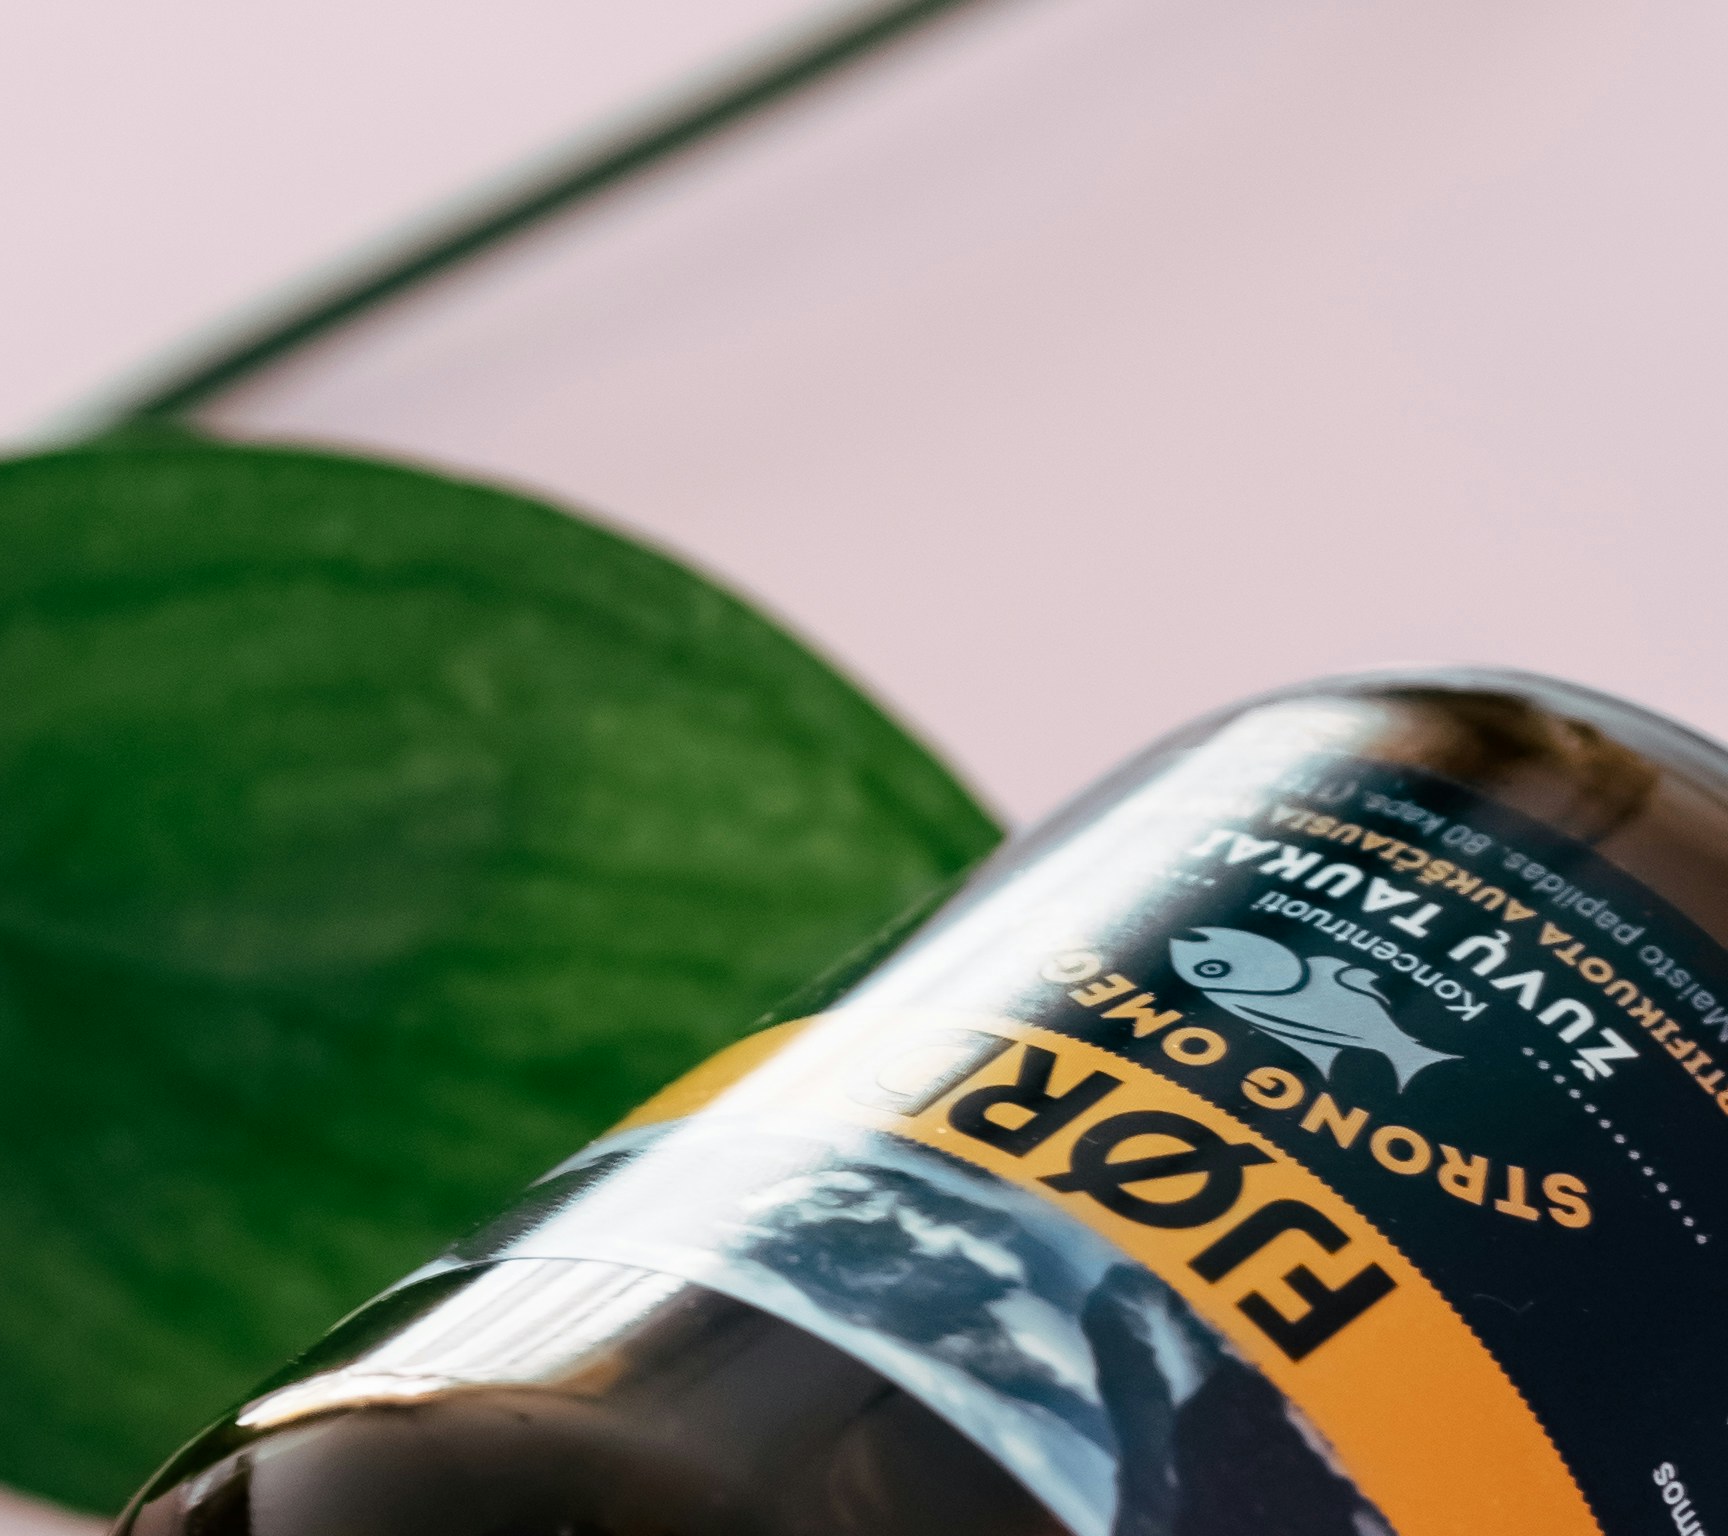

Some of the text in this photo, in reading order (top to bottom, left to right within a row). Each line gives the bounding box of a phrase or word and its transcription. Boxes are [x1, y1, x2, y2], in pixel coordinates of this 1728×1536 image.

[1249, 890, 1488, 1022] Koncentruoti
[1448, 929, 1640, 1082] ŽUVŲ
[1040, 948, 1593, 1229] STRONG OMEG
